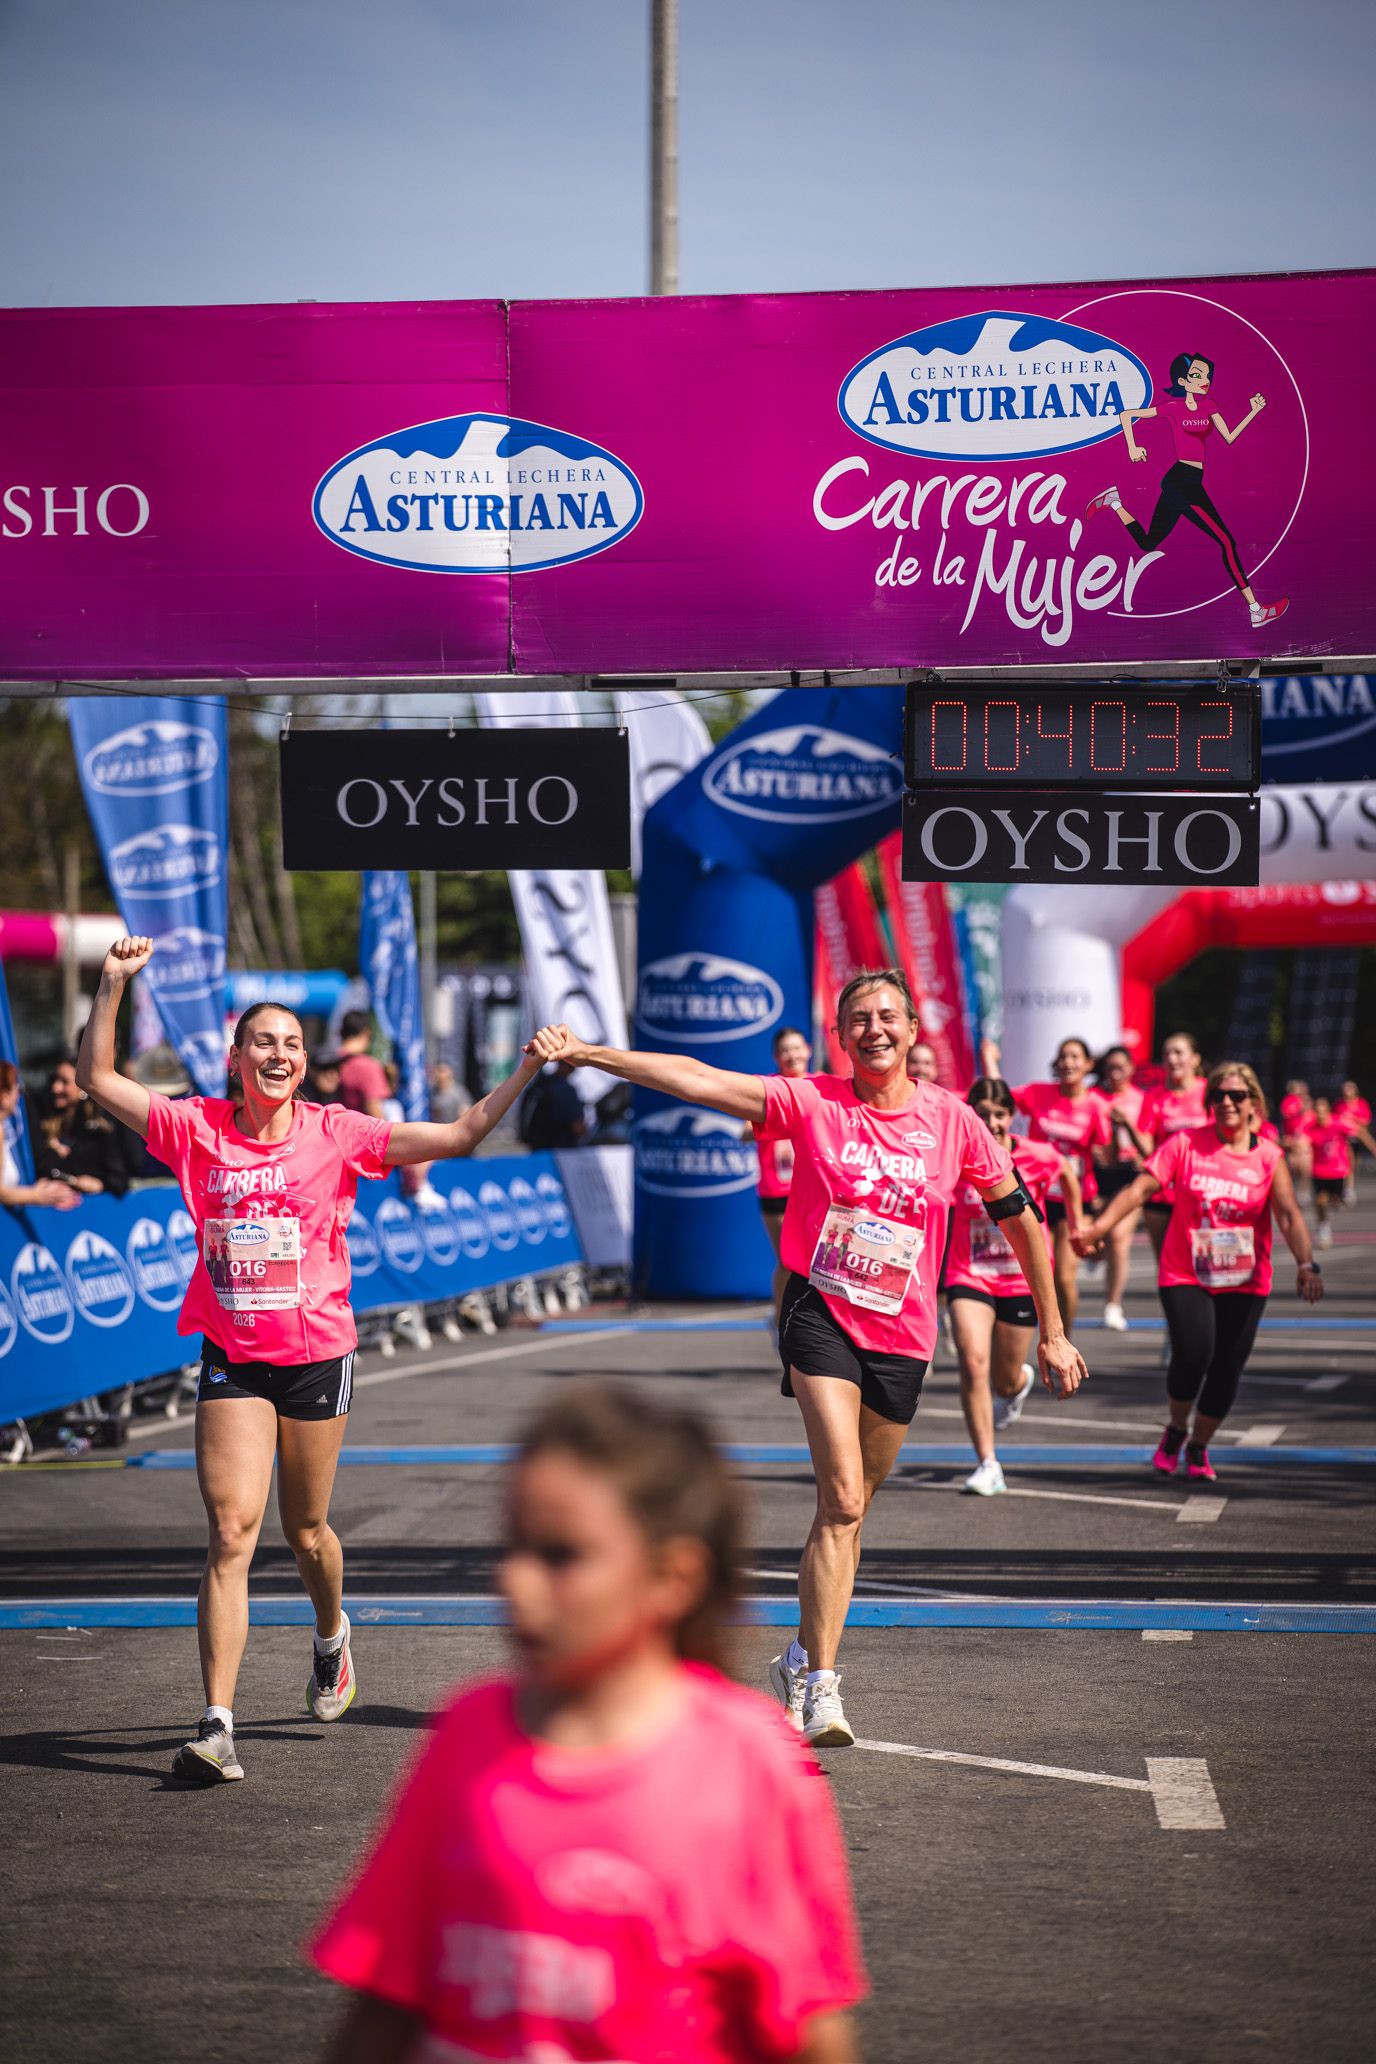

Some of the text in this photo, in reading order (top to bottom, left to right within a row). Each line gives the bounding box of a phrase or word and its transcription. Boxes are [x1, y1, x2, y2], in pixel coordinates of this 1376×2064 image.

[910, 359, 1118, 381] CENTRAL LECHERA
[863, 371, 1125, 426] ASTURIANA
[1182, 419, 1210, 427] OYSHO
[390, 468, 606, 485] CENTRAL LECHERA
[340, 474, 618, 533] ASTURIANA
[812, 456, 1068, 531] Carrera
[874, 519, 1167, 647] de la Mujer
[931, 701, 1234, 772] 00:40:32
[715, 758, 897, 800] ASTURIANA
[338, 776, 578, 828] OYSHO
[921, 807, 1242, 874] OYSHO
[207, 1165, 288, 1194] CARRERA
[229, 1233, 267, 1241] ASTURIANA
[857, 1225, 892, 1242] ASTURIANA
[229, 1261, 267, 1276] 016
[846, 1253, 884, 1276] 016
[233, 1312, 256, 1328] 2026
